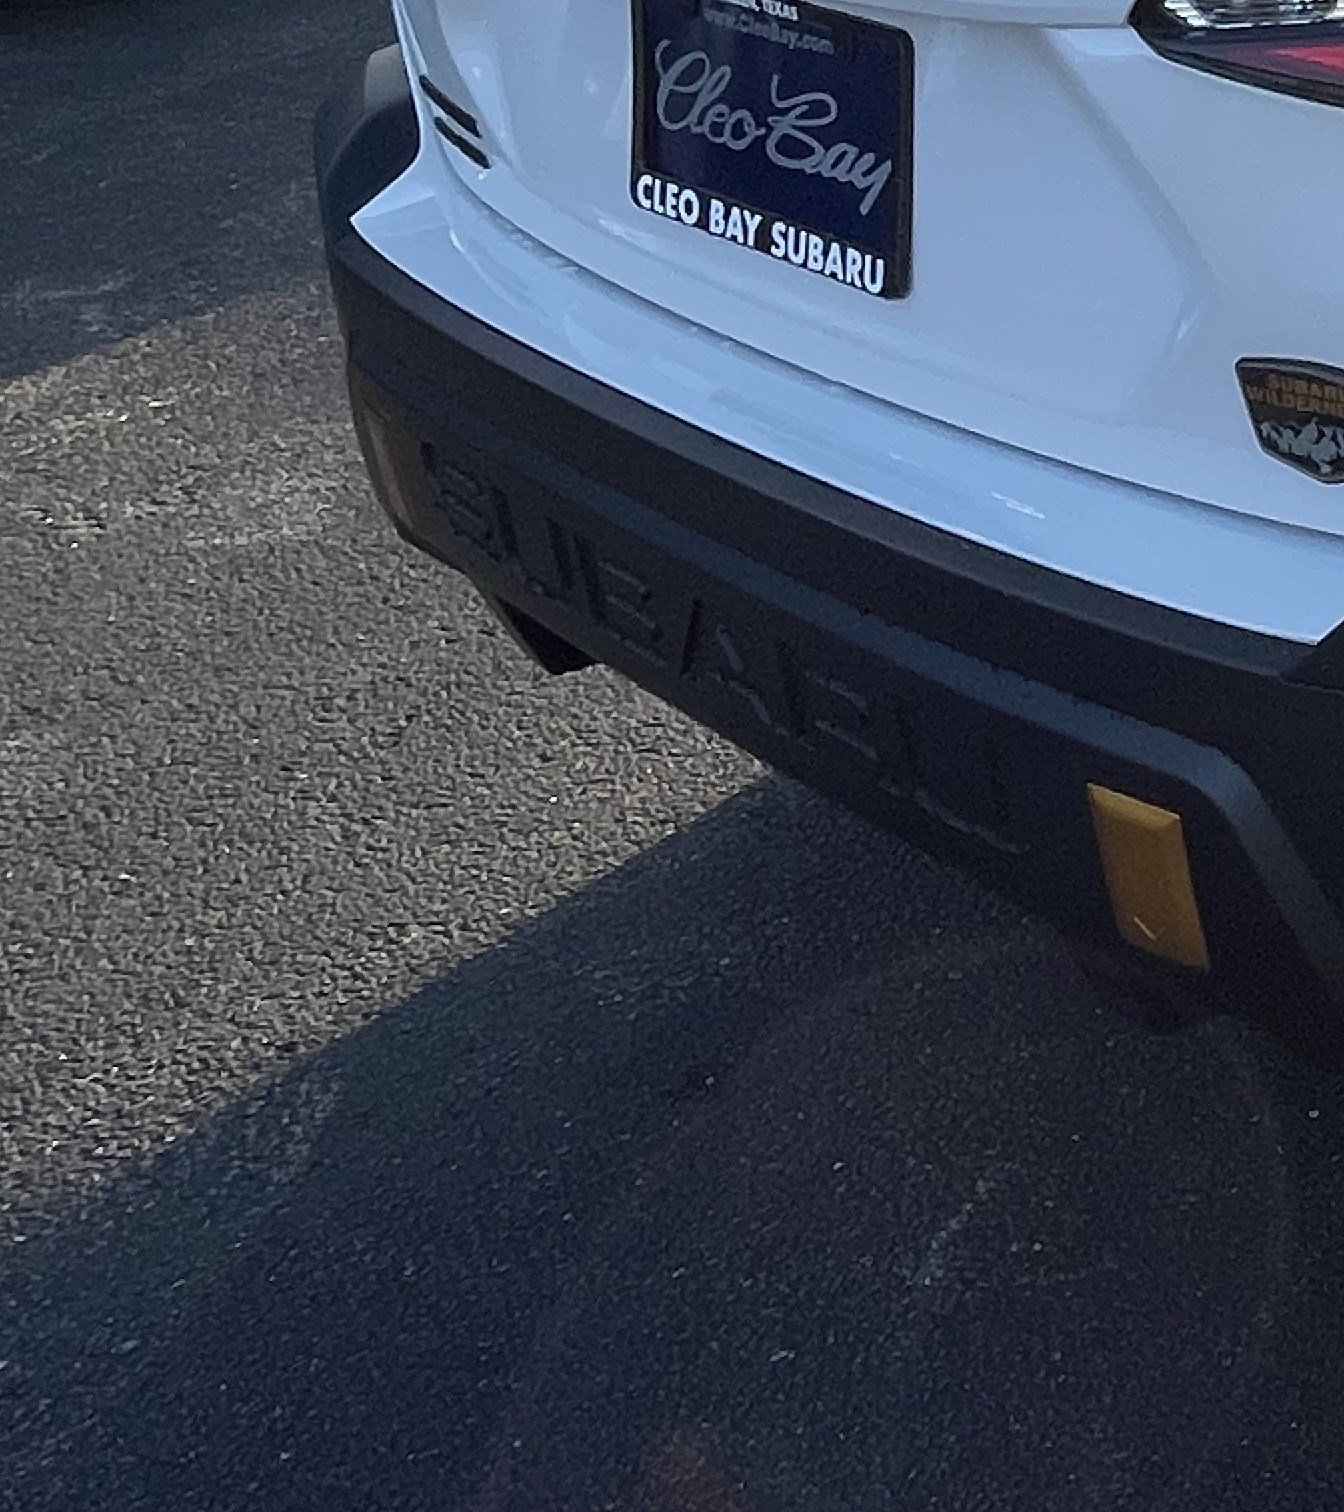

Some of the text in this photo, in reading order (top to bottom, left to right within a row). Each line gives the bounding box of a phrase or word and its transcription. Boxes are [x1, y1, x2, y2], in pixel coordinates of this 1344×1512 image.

[654, 38, 893, 217] Cleo Bay
[635, 174, 887, 295] CLEO BAY SUBARU
